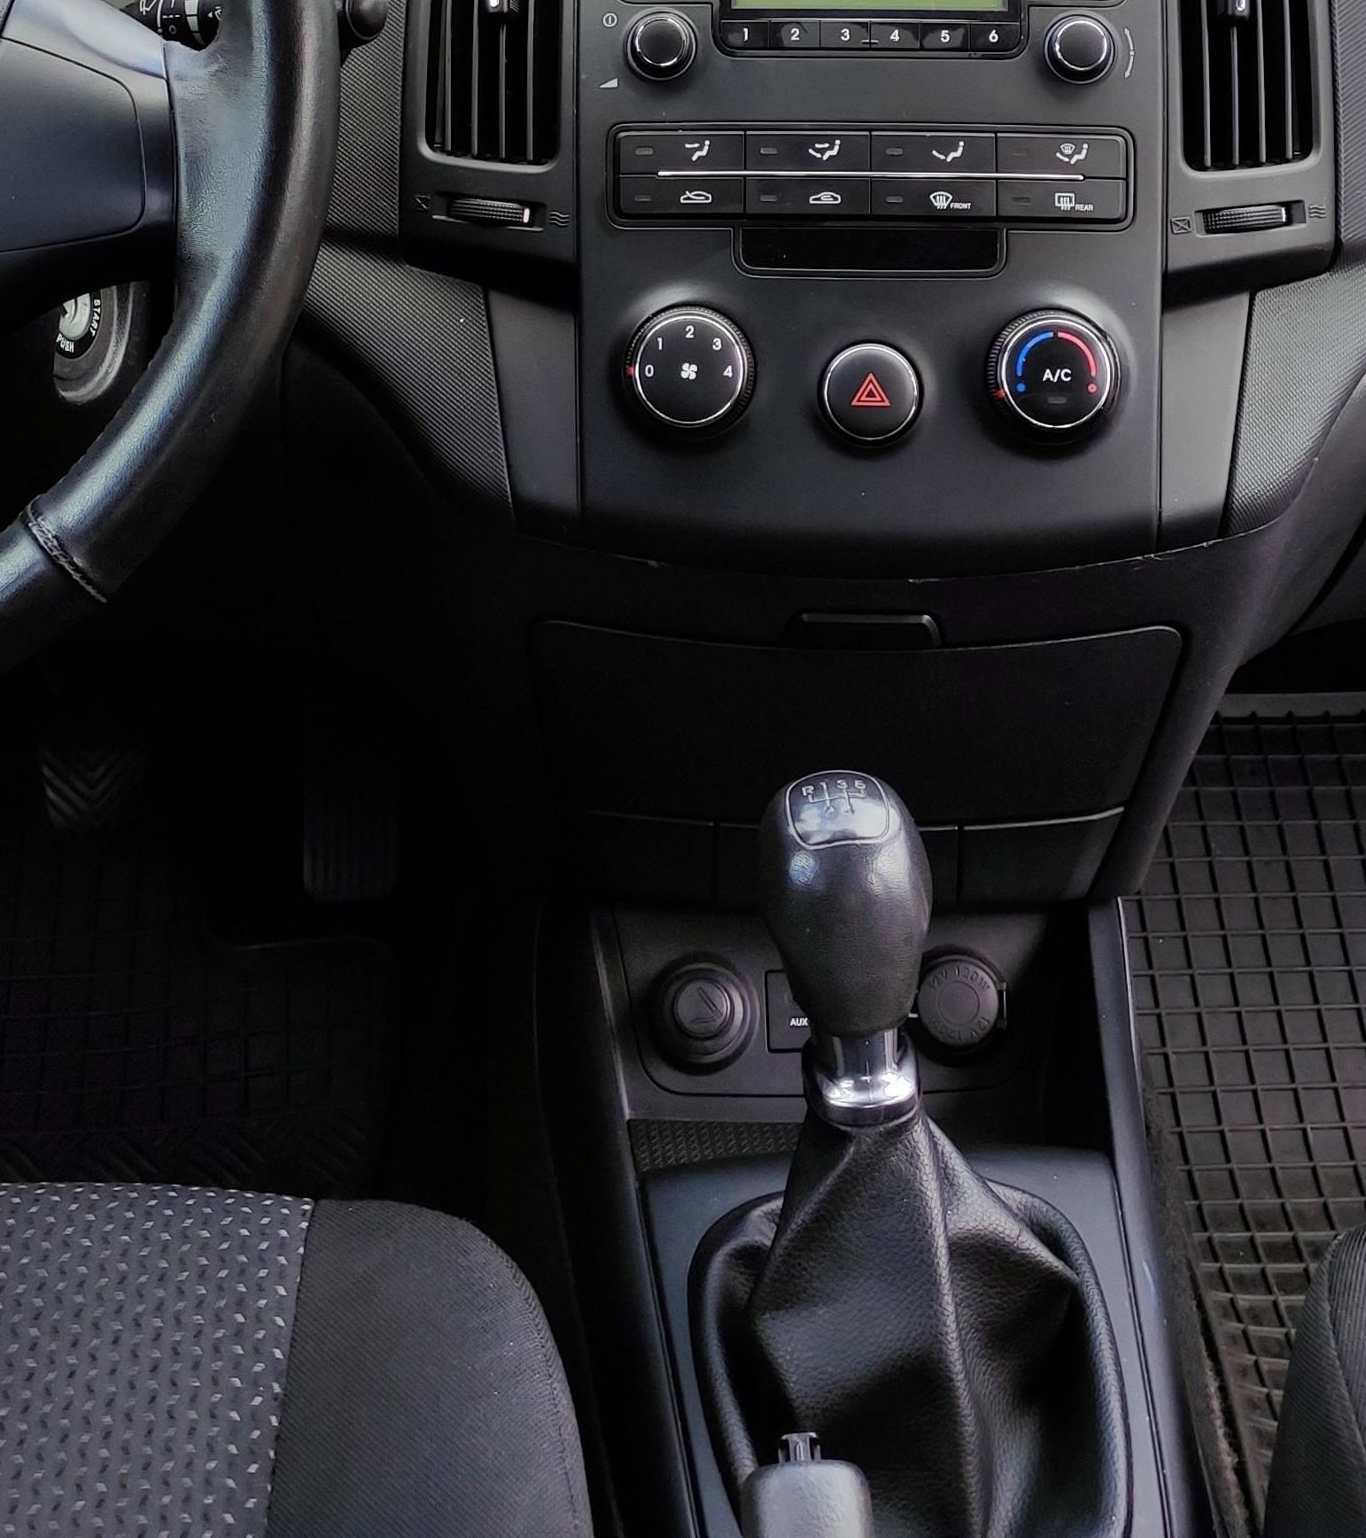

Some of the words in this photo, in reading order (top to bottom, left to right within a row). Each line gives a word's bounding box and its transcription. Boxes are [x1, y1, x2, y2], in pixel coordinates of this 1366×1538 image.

[743, 28, 749, 41] 1
[790, 28, 800, 41] 2
[841, 29, 850, 42] 3
[890, 30, 900, 42] 4
[940, 30, 950, 43] 5
[989, 30, 999, 43] 6
[950, 202, 972, 210] FRONT
[89, 299, 101, 337] START
[685, 325, 695, 339] 2
[56, 333, 74, 353] PUSH
[657, 337, 663, 351] 1
[712, 337, 722, 351] 3
[644, 364, 654, 377] 0
[723, 365, 733, 378] 4
[1042, 367, 1072, 383] A/C
[801, 785, 815, 797] R
[789, 1017, 809, 1027] AUX
